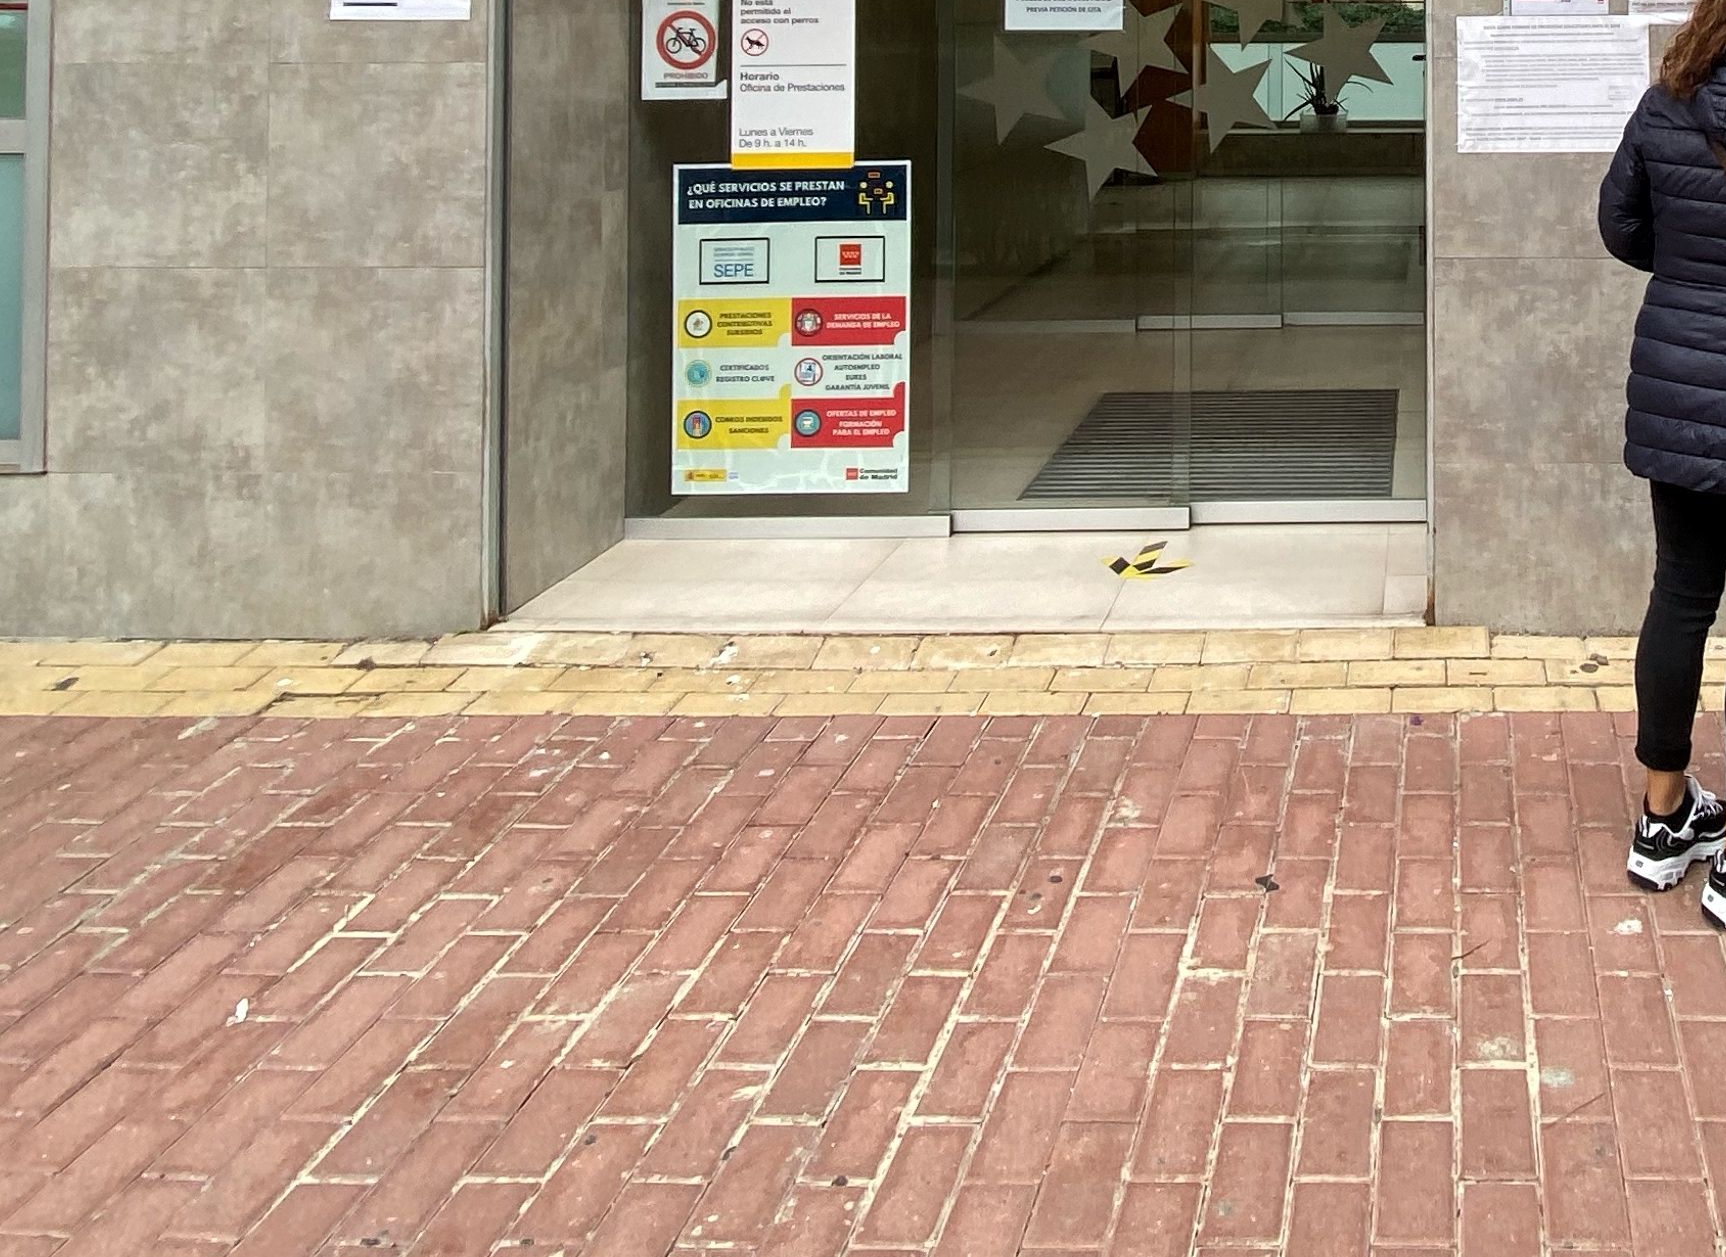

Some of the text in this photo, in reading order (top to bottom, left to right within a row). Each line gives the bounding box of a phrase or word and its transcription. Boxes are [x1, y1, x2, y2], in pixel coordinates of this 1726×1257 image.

[740, 8, 781, 16] permitido
[791, 17, 819, 25] perros
[740, 72, 780, 81] Horario
[740, 83, 845, 92] Oficina de Prestaciones
[739, 128, 768, 137] Lunes
[779, 127, 814, 136] Viernes
[739, 139, 752, 148] De
[755, 139, 761, 148] 9
[784, 139, 795, 147] 14
[687, 181, 845, 195] ¿QUÉ SERVICIOS SE PRESTAN
[689, 197, 827, 209] EN OFICINAS DE EMPLEO?
[713, 263, 754, 278] SEPE
